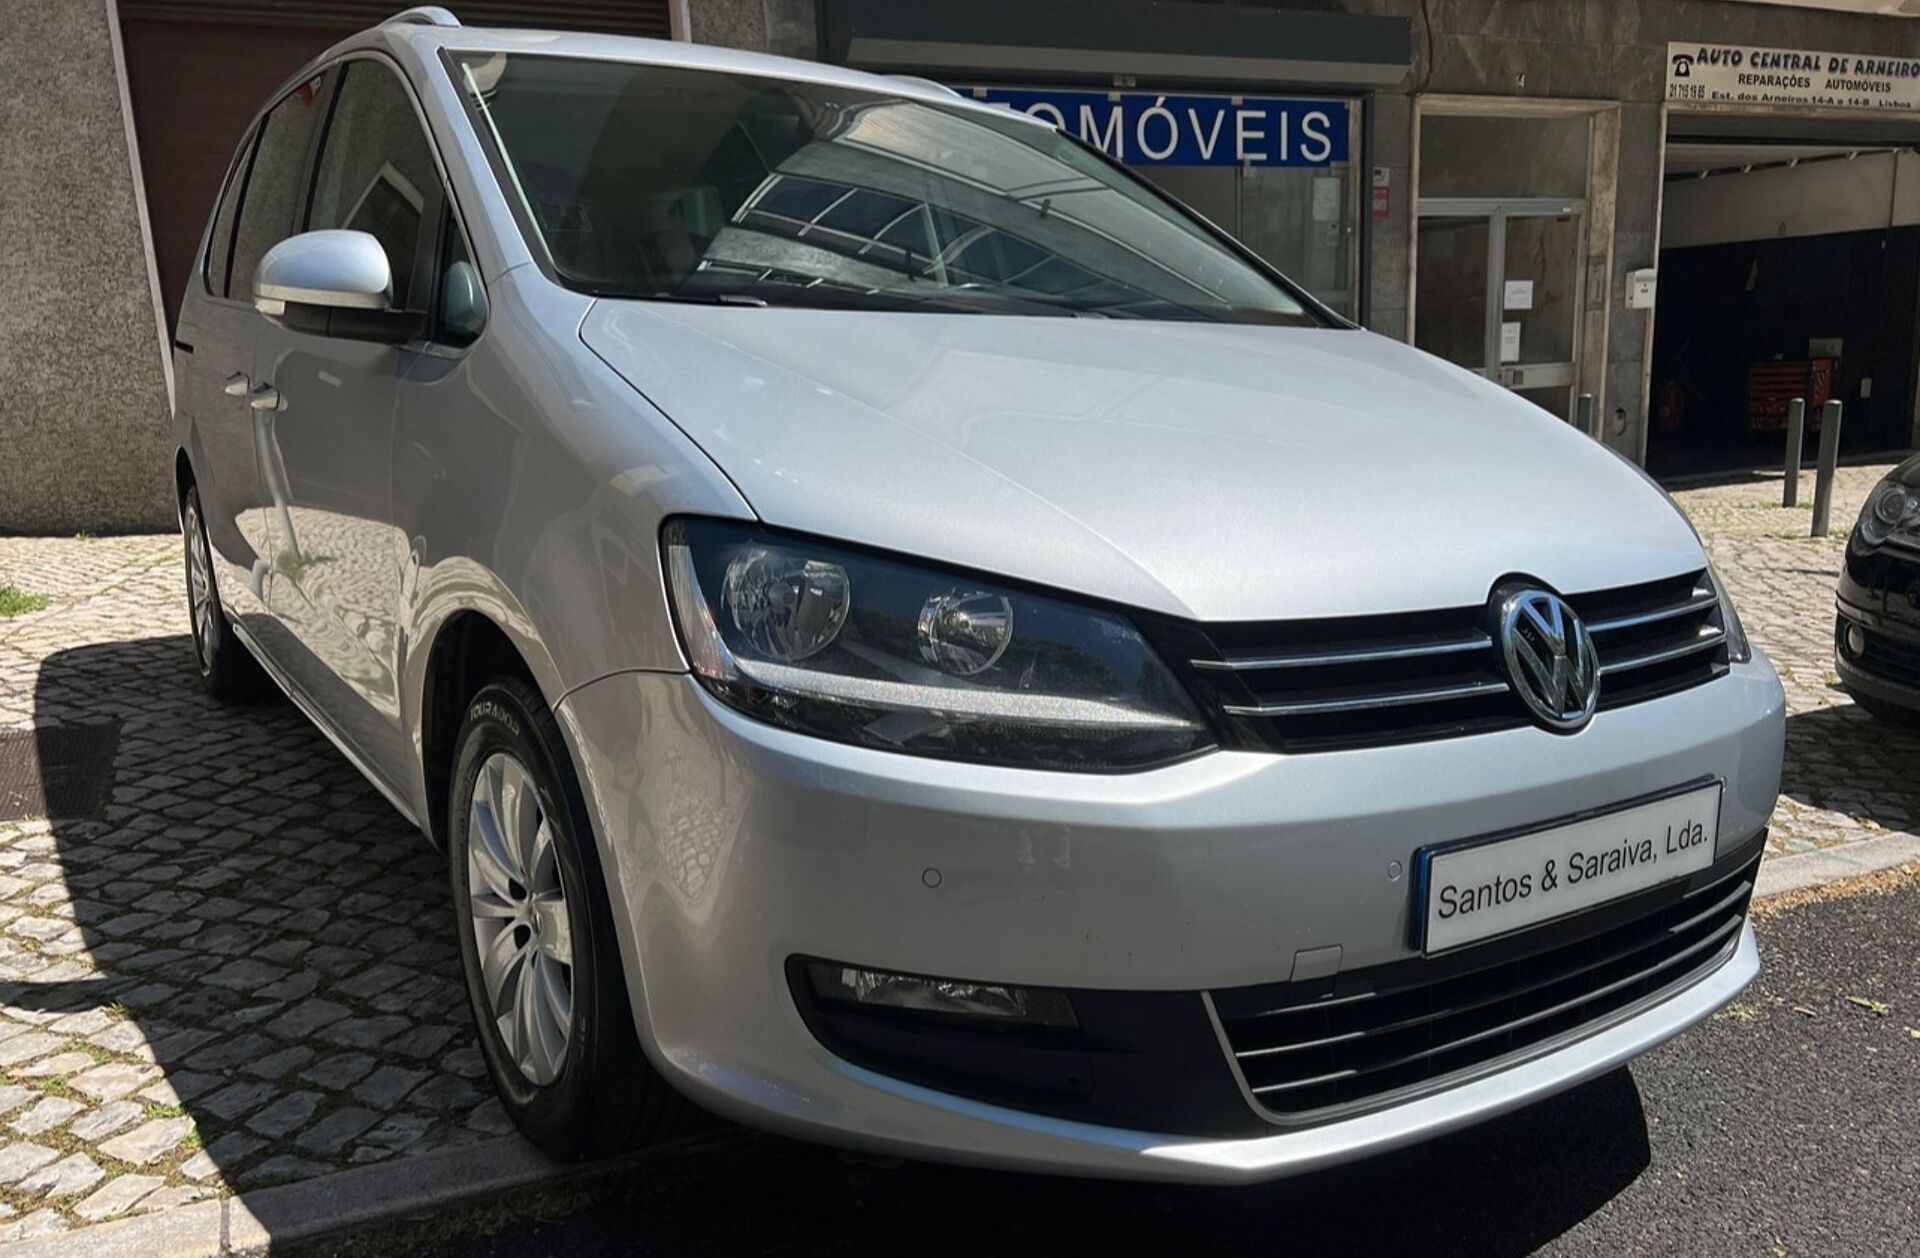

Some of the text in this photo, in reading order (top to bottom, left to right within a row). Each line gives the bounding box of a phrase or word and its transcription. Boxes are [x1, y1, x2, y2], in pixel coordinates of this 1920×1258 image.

[1696, 47, 1743, 67] AUTO
[1750, 51, 1821, 71] CENTRAL
[1828, 57, 1848, 73] DE
[1738, 73, 1891, 93] REPARAÇÕES AUTOMÓVEIS
[1712, 91, 1734, 100] Est.
[1737, 93, 1758, 101] dos
[1762, 93, 1808, 104] Arneiros
[1879, 99, 1912, 109] Lisboa
[1438, 819, 1708, 919] Santos & Saraiva, Lda.
